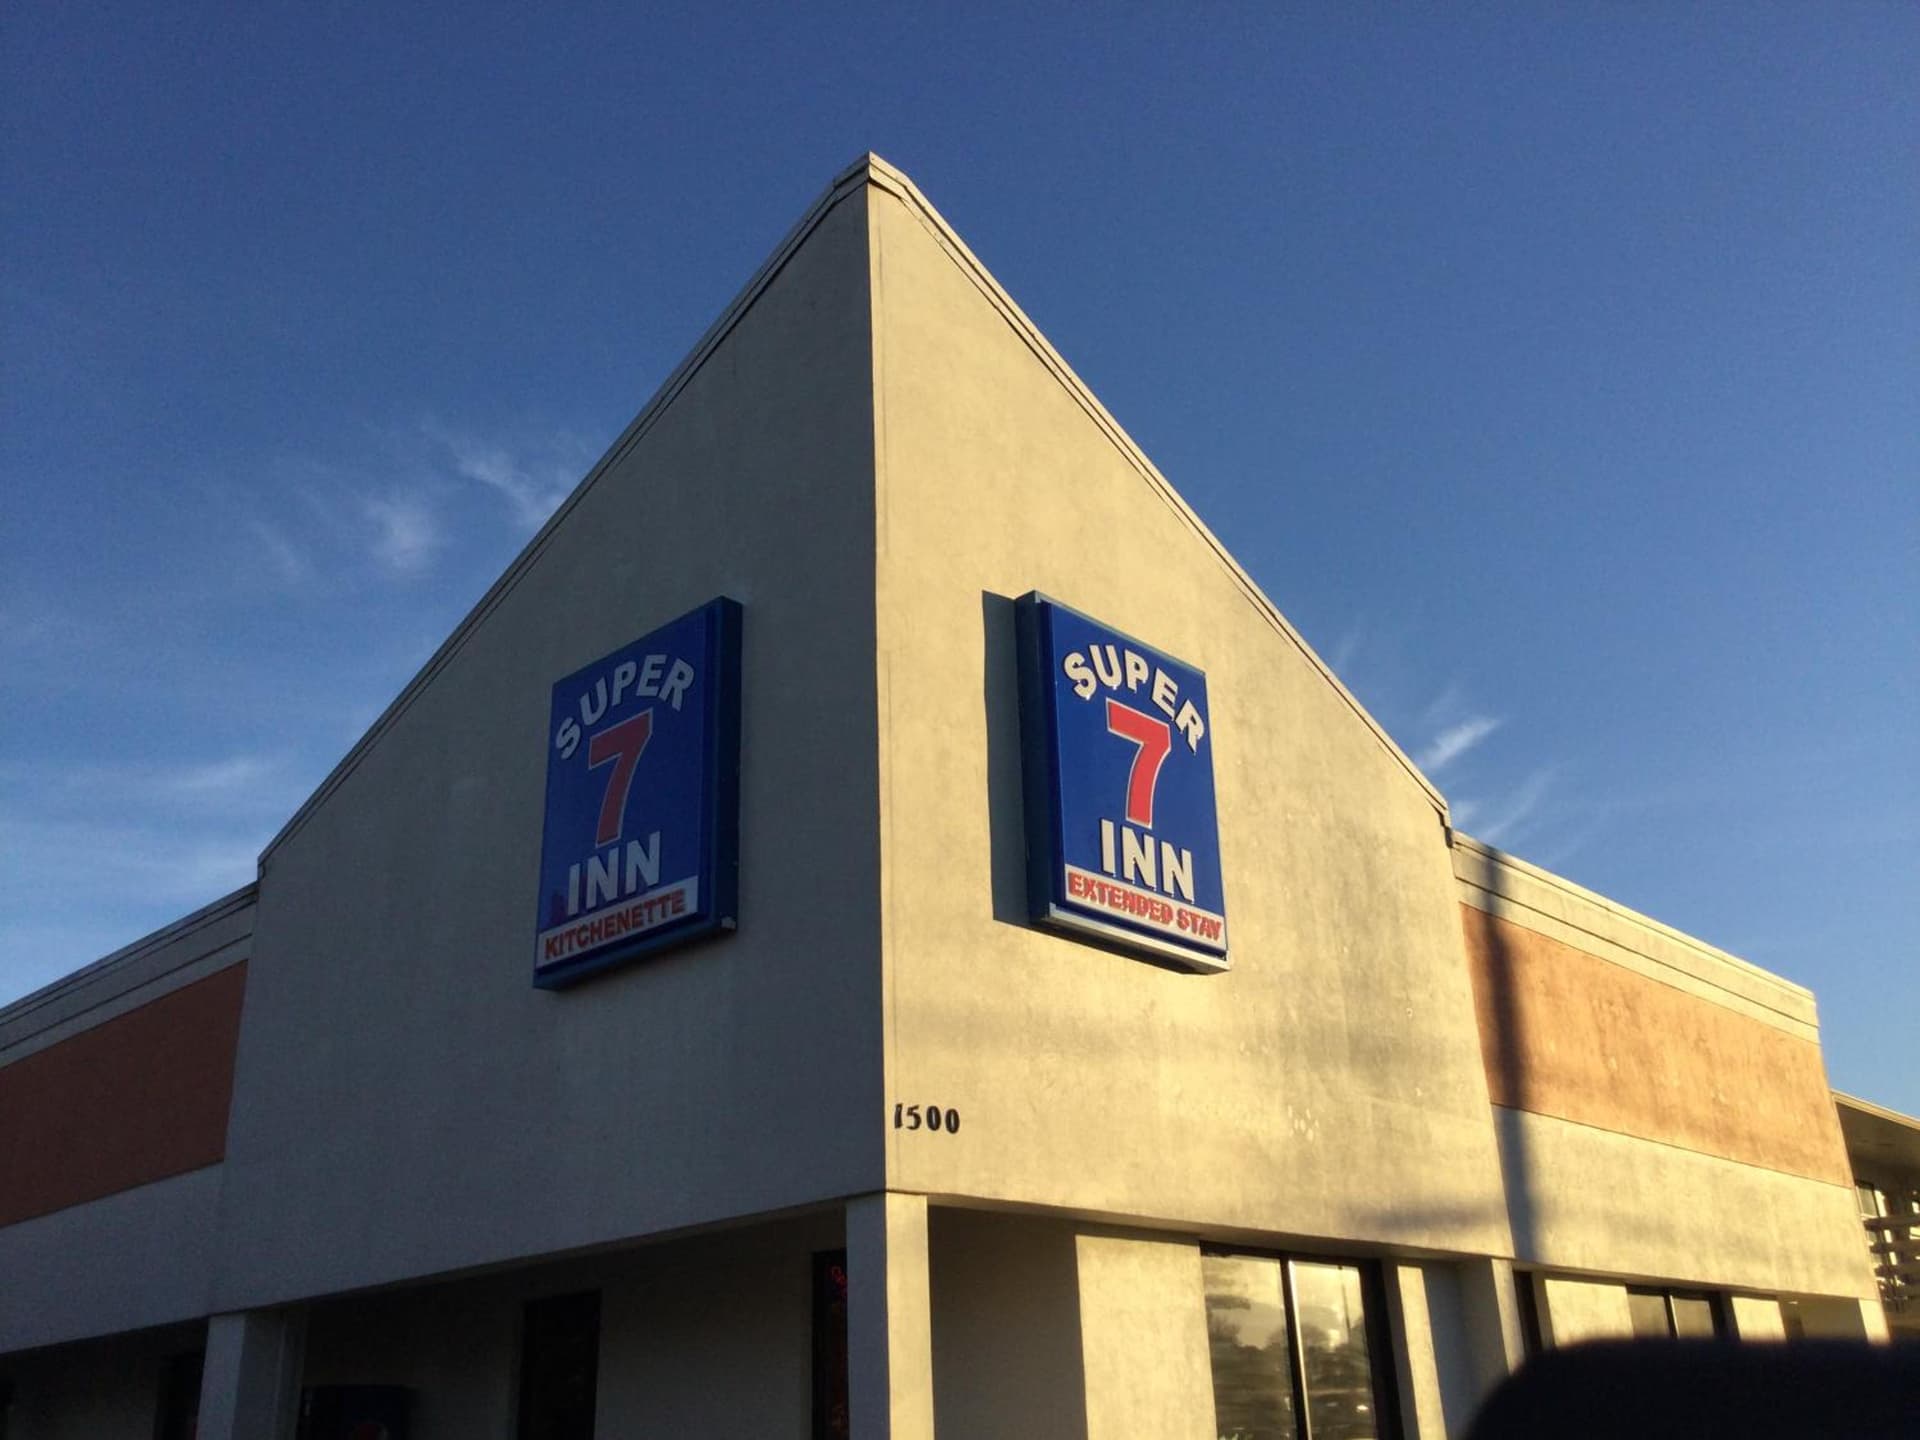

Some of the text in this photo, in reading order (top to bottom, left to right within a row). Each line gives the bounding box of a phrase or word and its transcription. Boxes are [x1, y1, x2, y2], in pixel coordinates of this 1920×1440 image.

[555, 654, 695, 760] SUPER
[1064, 644, 1205, 755] SUPER
[588, 707, 653, 848] 7
[1106, 697, 1171, 829] 7
[566, 831, 661, 917] INN
[1100, 818, 1194, 904] INN
[545, 889, 686, 960] KITCHENETTE
[1067, 872, 1222, 941] EXTENDED STAY
[894, 1102, 960, 1134] 1500
